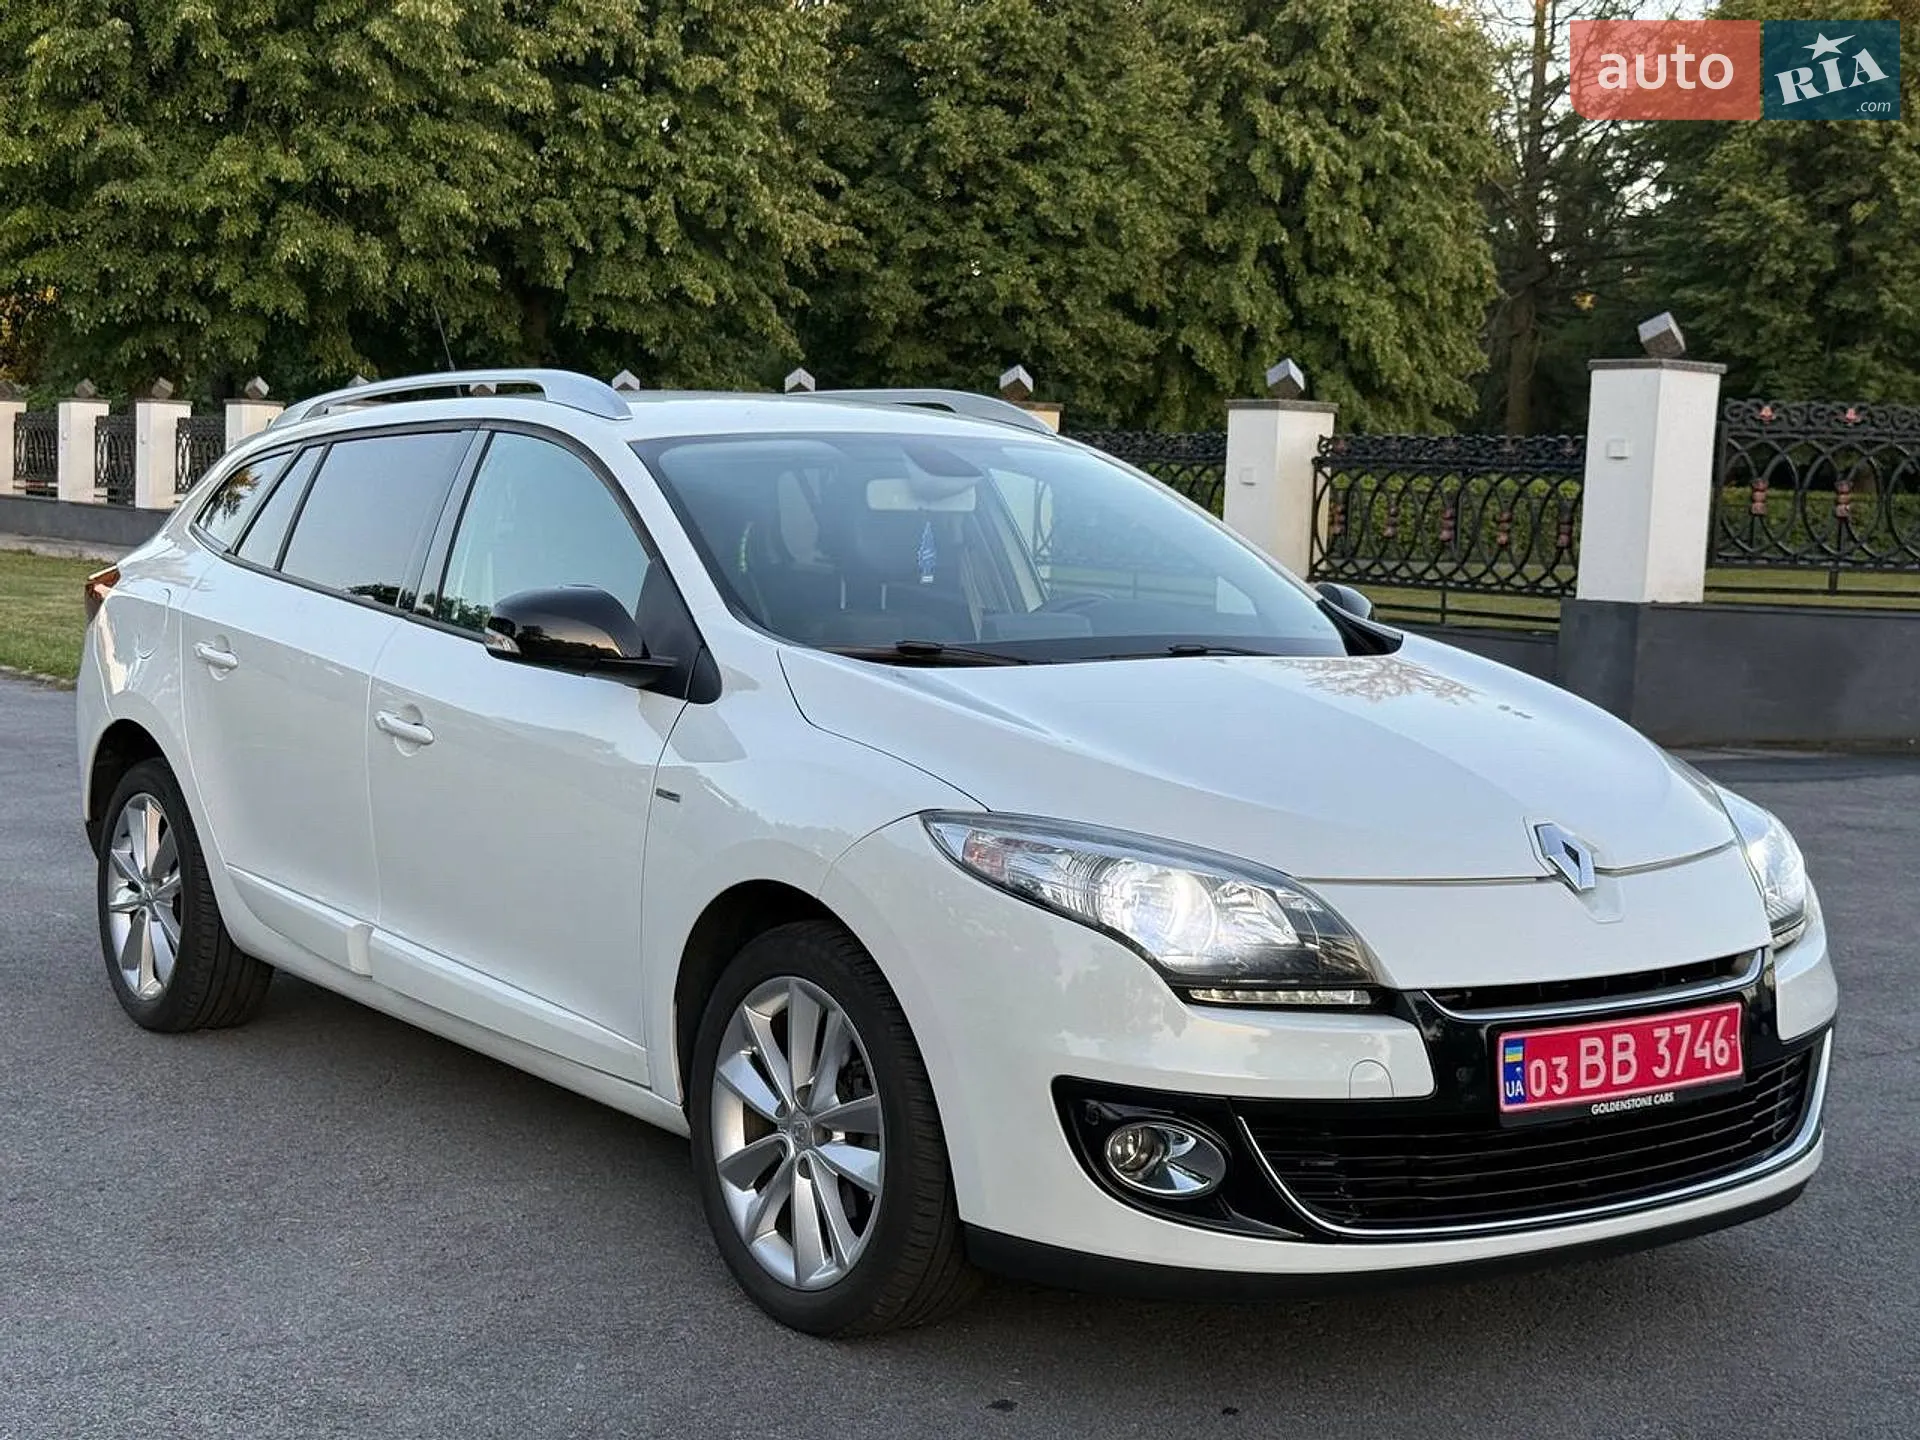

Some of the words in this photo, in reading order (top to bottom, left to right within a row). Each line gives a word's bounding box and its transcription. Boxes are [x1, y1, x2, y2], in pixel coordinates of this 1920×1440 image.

[1529, 1056, 1569, 1098] 03
[1579, 1033, 1638, 1089] BB
[1651, 1015, 1730, 1079] 3746
[1505, 1080, 1525, 1098] UA
[1591, 1095, 1654, 1115] GOLDENSTONE
[1654, 1092, 1675, 1105] CARS
